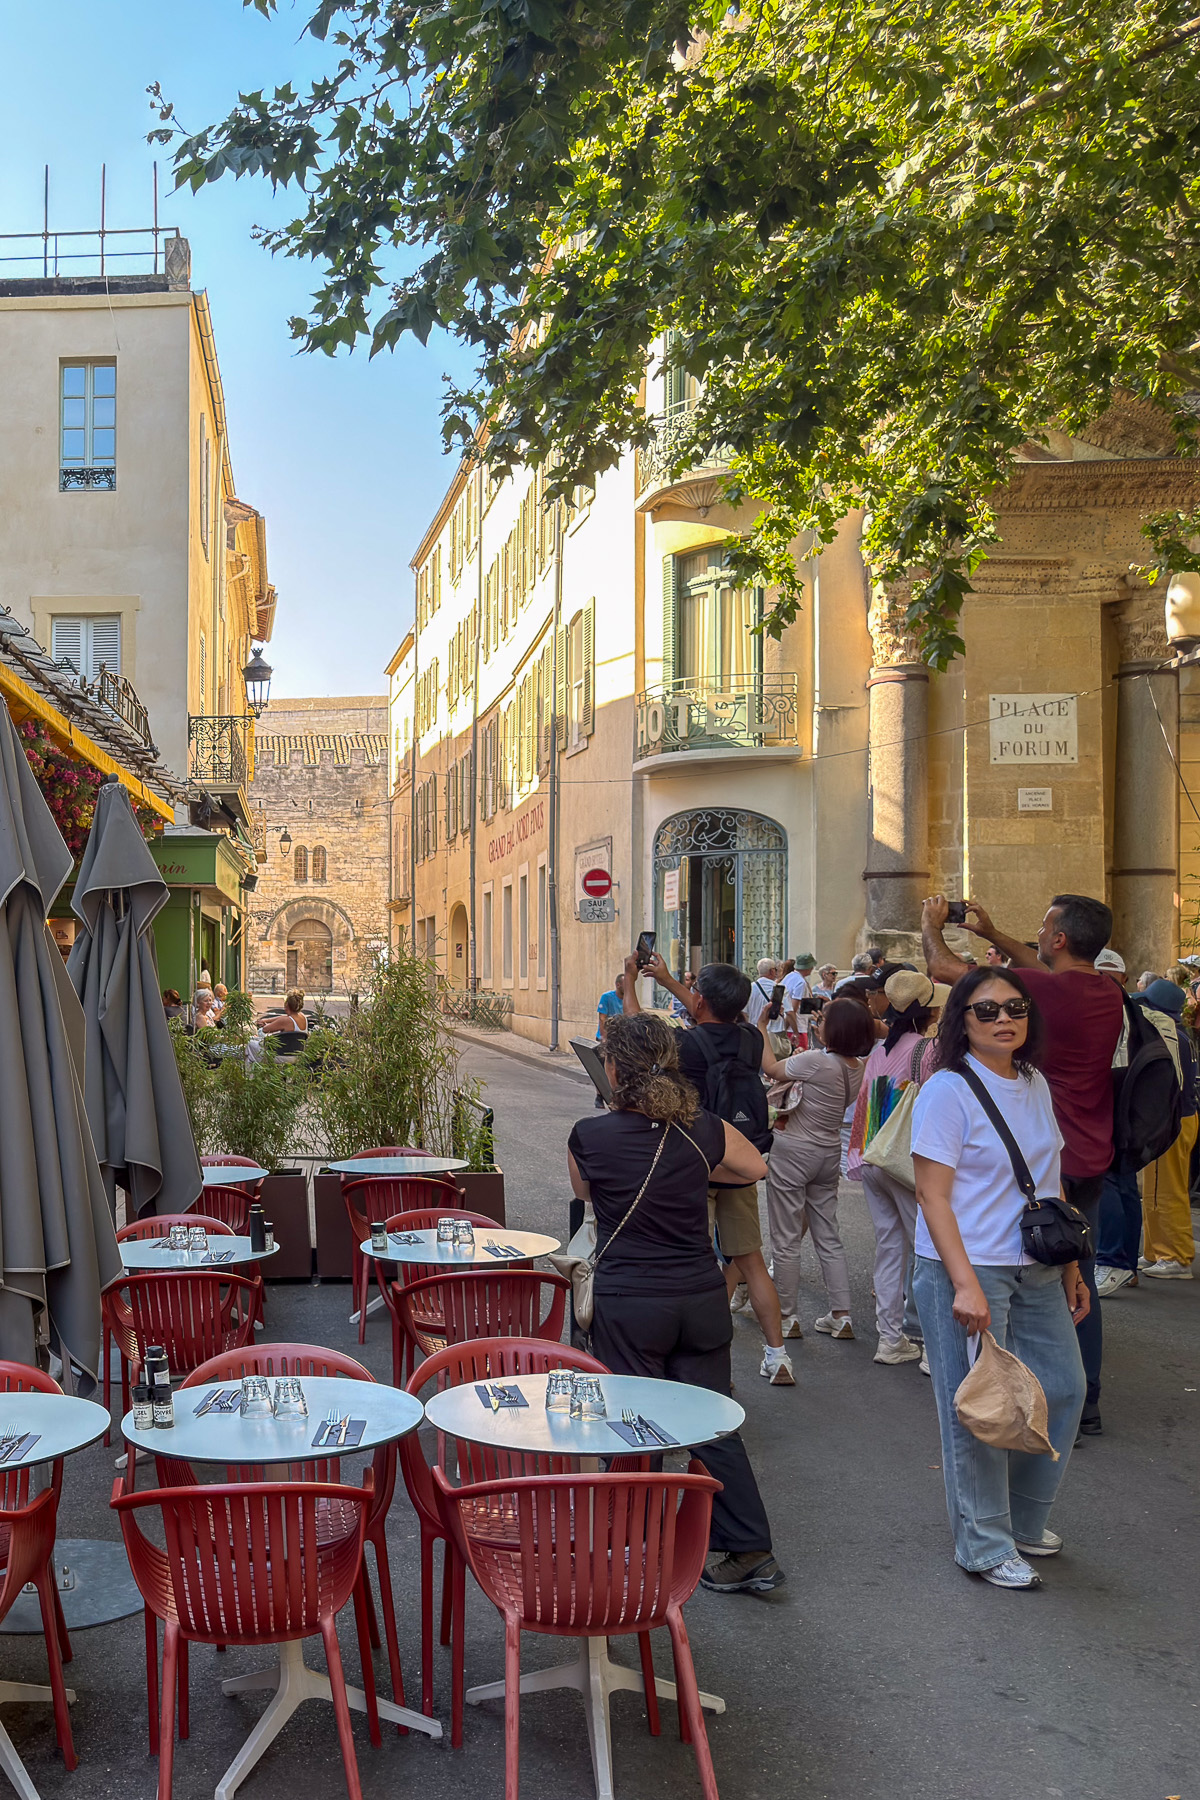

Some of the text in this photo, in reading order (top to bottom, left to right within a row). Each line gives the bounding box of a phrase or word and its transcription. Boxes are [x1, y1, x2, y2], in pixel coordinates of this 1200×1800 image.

[1000, 701, 1069, 718] PLACE
[638, 693, 777, 749] HOTEL
[1024, 723, 1043, 734] DU
[1000, 740, 1069, 757] FORUM
[488, 835, 506, 864] GRAND
[516, 812, 530, 845] NORD
